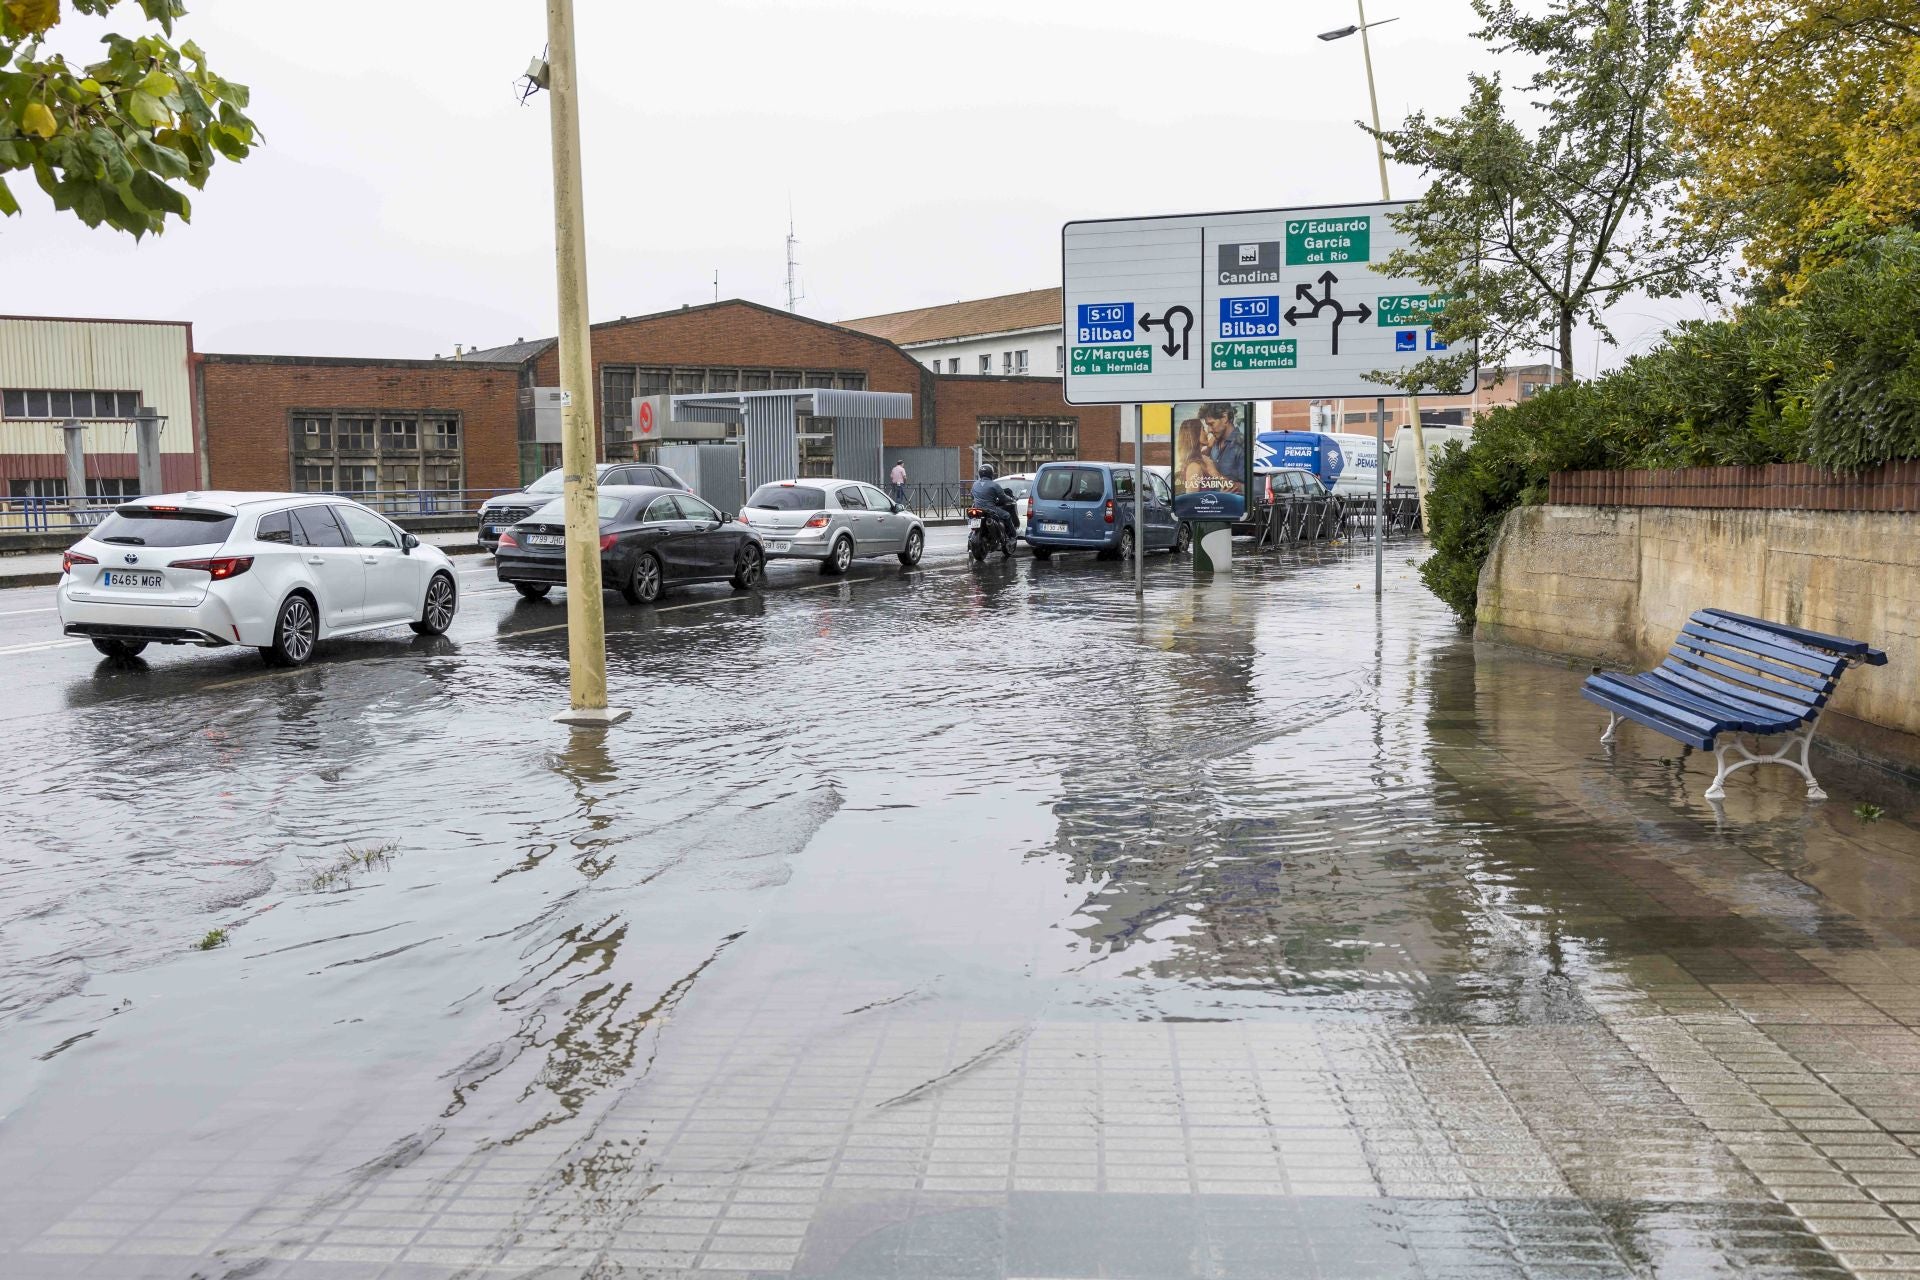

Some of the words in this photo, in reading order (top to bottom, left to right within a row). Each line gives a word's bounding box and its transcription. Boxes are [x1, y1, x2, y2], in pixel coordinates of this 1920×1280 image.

[1289, 220, 1367, 234] C/Eduardo
[1304, 236, 1350, 248] García
[1307, 252, 1324, 262] del
[1331, 252, 1348, 261] Río
[1220, 271, 1278, 283] Candina
[1091, 308, 1121, 320] S-10
[1234, 302, 1266, 314] S-10
[1080, 328, 1132, 341] Bilbao
[1222, 322, 1277, 336] Bilbao
[1074, 347, 1149, 361] C/Marqués
[1214, 342, 1294, 356] C/Marqués
[1074, 365, 1086, 373] de
[1092, 364, 1100, 372] la
[1107, 363, 1148, 372] Hermida
[1214, 360, 1227, 368] de
[1233, 359, 1242, 368] la
[1250, 358, 1293, 367] Hermida
[1200, 480, 1234, 489] SABINAS
[112, 574, 138, 586] 6465
[141, 576, 161, 587] MGR
